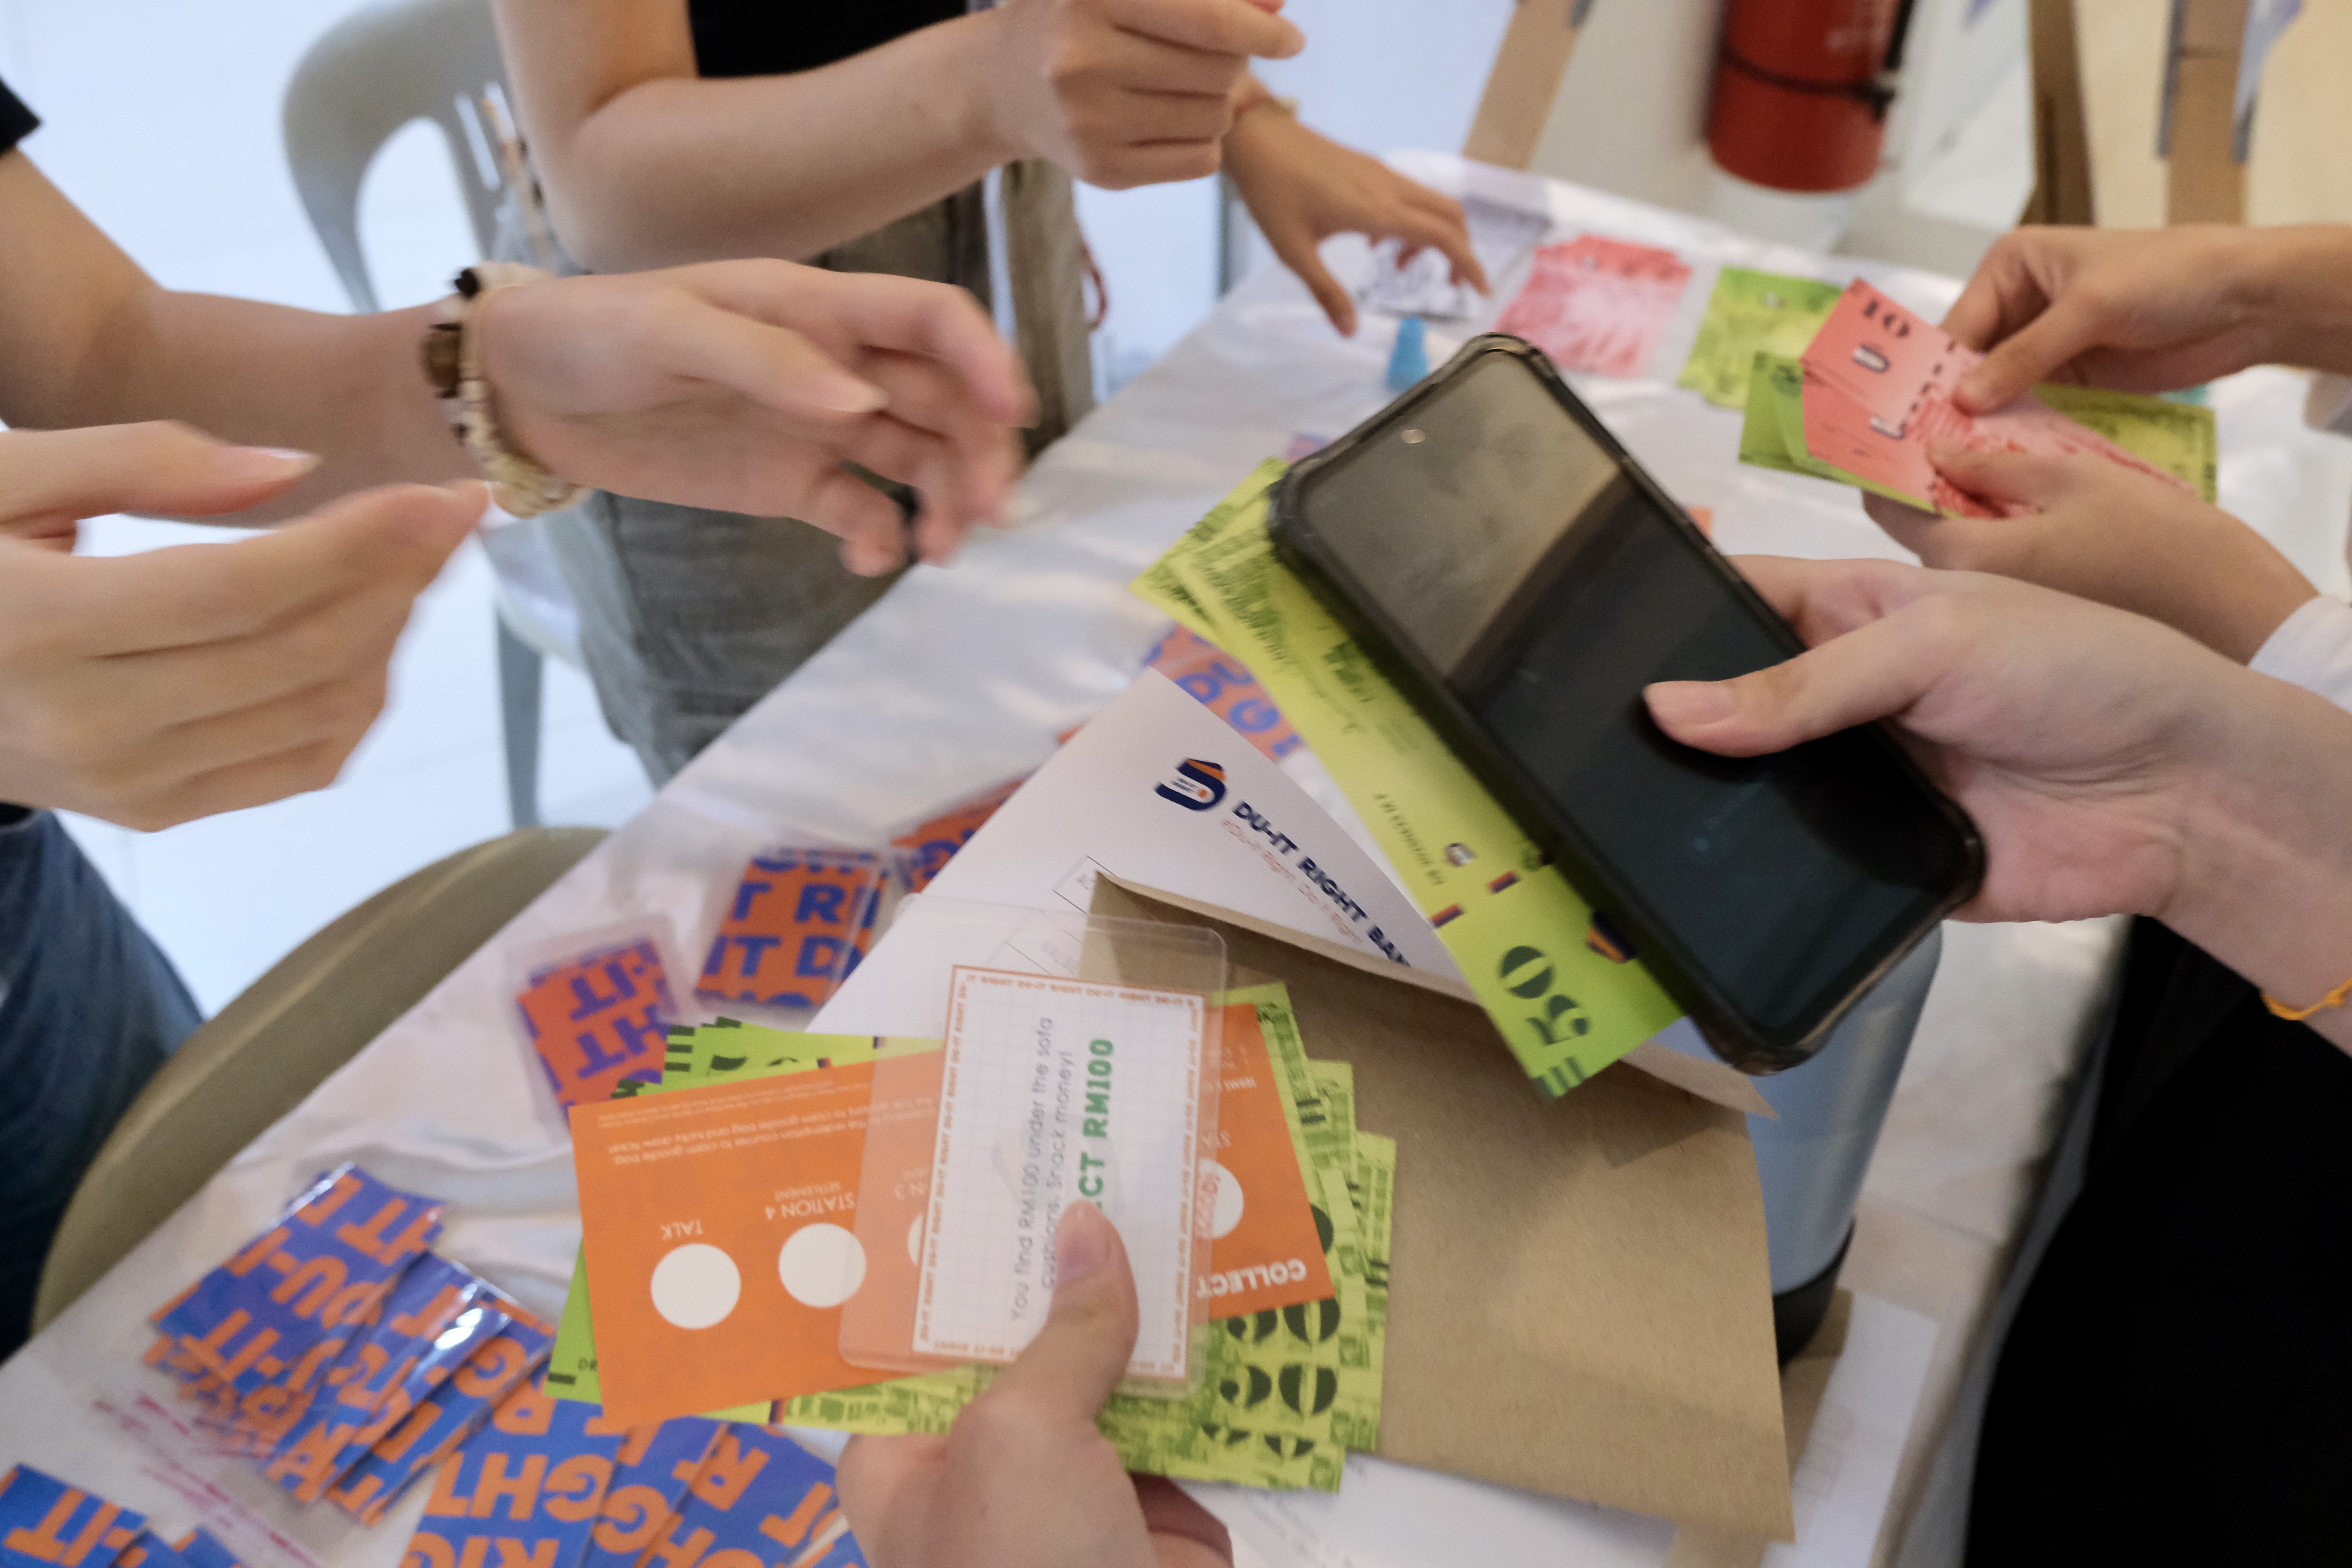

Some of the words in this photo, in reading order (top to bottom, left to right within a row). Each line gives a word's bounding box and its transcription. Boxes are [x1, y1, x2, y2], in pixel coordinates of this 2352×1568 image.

[1864, 300, 1911, 338] 10
[1234, 801, 1298, 856] DU-IT
[1298, 856, 1367, 923] RIGHT
[1499, 945, 1590, 1046] 50
[1035, 1017, 1054, 1057] sofa
[1031, 1061, 1050, 1094] the
[1052, 1050, 1077, 1124] money!
[1081, 1038, 1116, 1139] RM100
[1025, 1100, 1046, 1158] under
[1046, 1129, 1068, 1190] Snack
[764, 1205, 776, 1220] 4
[779, 1190, 856, 1218] STATION
[1018, 1162, 1040, 1229] RM100
[659, 1218, 704, 1240] TALK
[1015, 1236, 1034, 1275] find
[1197, 1258, 1306, 1299] COLLECT
[1011, 1281, 1031, 1322] You
